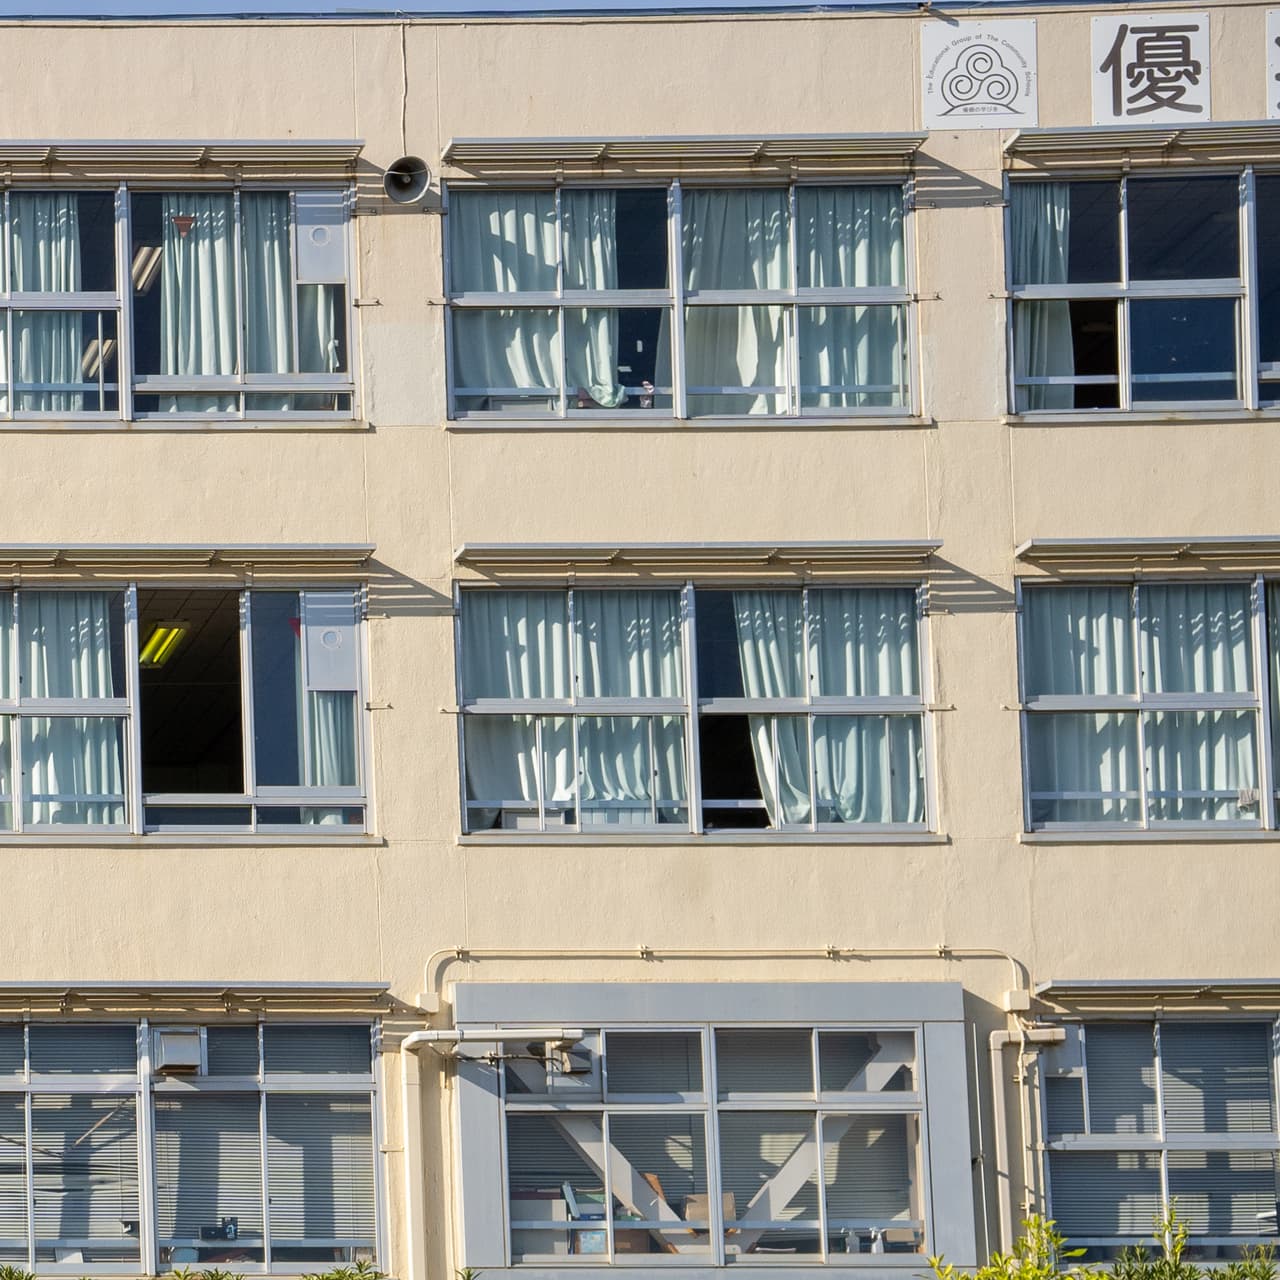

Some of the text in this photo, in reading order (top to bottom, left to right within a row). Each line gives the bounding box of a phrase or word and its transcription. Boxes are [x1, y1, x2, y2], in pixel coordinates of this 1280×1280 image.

[951, 35, 972, 47] Group
[987, 33, 999, 42] The
[1099, 23, 1204, 117] 優
